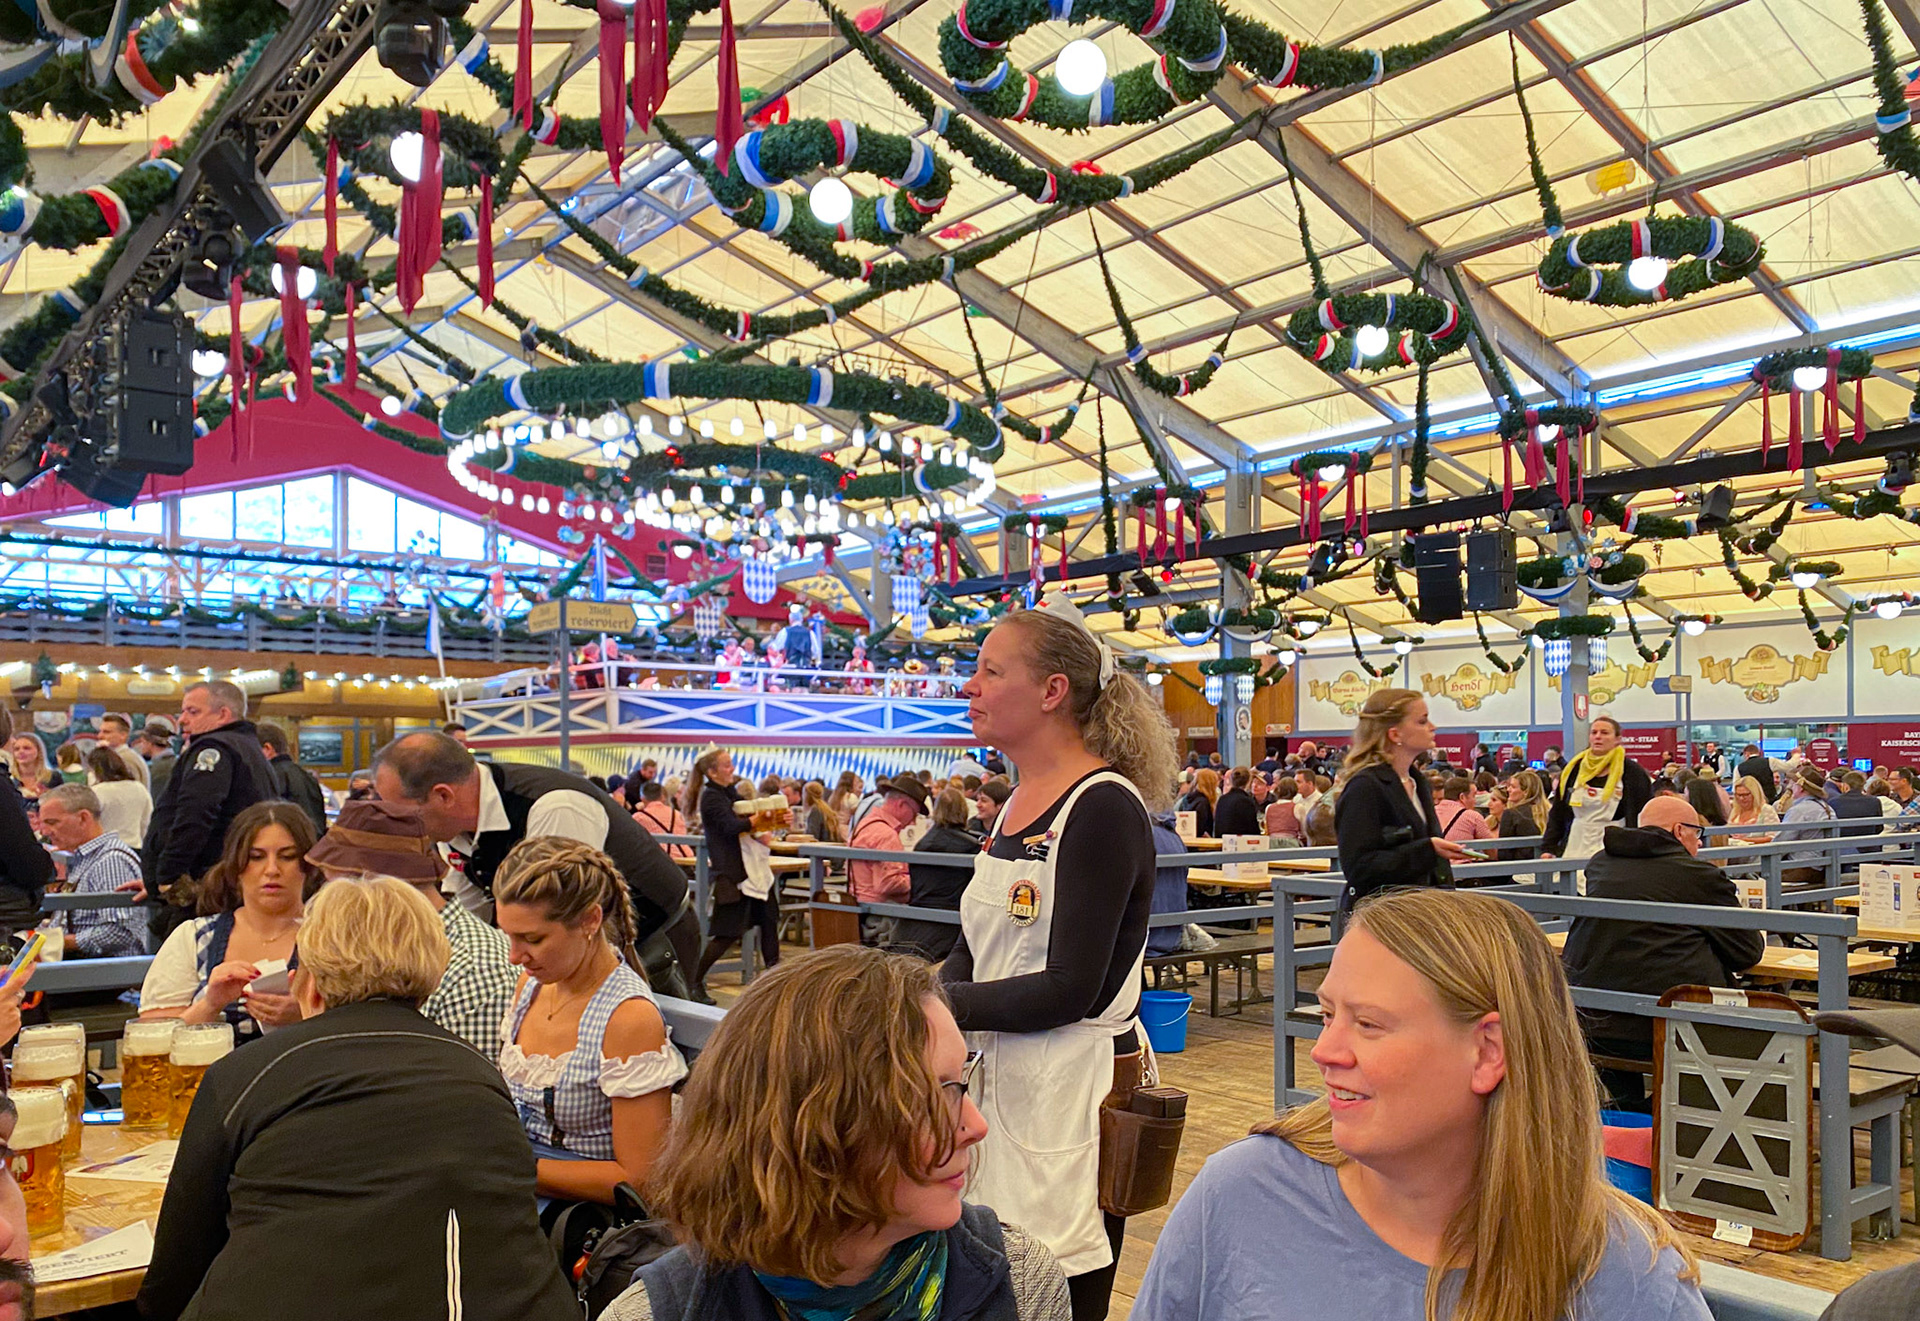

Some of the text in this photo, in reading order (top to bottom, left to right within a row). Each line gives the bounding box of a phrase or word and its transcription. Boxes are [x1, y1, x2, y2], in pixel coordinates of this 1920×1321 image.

[571, 616, 629, 629] reserviert
[1451, 679, 1483, 692] Hendl
[1015, 905, 1028, 915] 181
